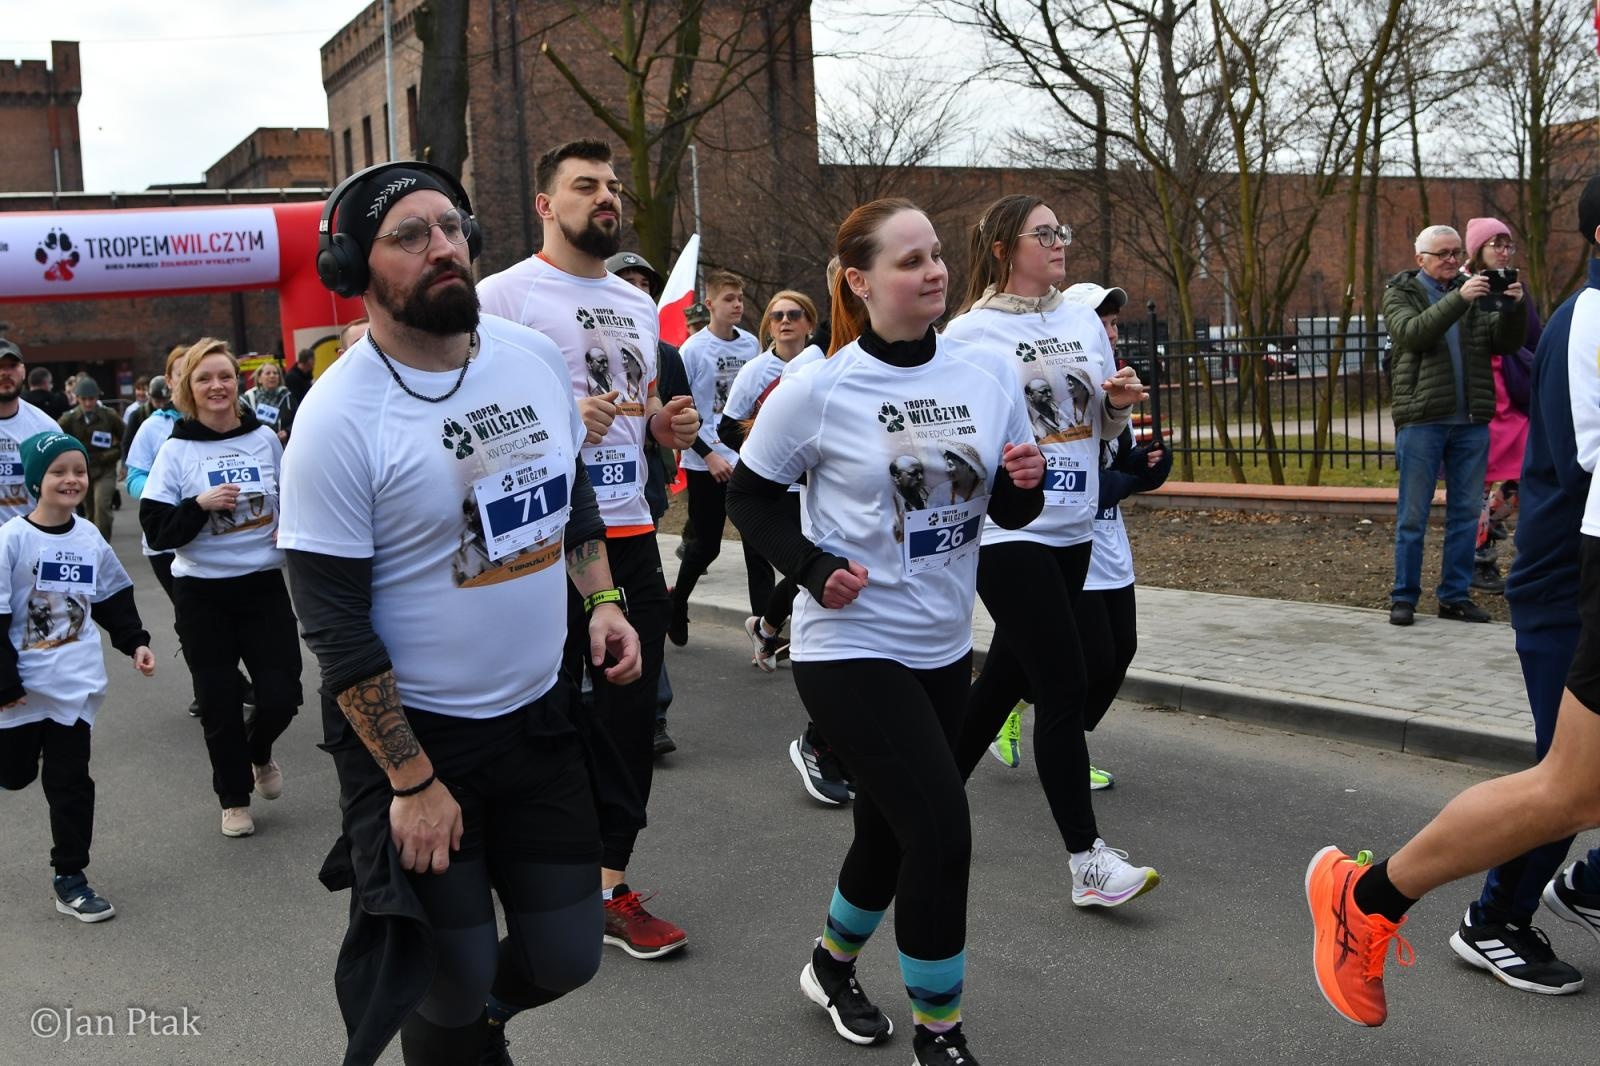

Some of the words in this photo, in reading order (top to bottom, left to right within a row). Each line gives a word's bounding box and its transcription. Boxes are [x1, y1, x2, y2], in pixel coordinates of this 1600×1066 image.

[596, 315, 636, 328] WILCZYM
[1034, 337, 1059, 346] TROPEM
[1038, 341, 1083, 355] WILCZYM
[465, 403, 501, 423] TROPEM
[904, 398, 937, 410] TROPEM
[472, 405, 539, 441] WILCZYM
[908, 405, 970, 424] WILCZYM
[928, 428, 957, 438] EDYCJA
[957, 425, 976, 435] 2026
[486, 445, 500, 460] XIV
[500, 437, 530, 455] EDYCJA
[529, 429, 549, 444] 2026
[220, 468, 252, 484] 126
[515, 466, 532, 477] TROPEM
[516, 466, 548, 486] WILCZYM
[602, 464, 624, 484] 88
[1052, 471, 1076, 491] 20
[514, 486, 549, 523] 71
[942, 511, 969, 523] WILCZYM
[936, 524, 964, 552] 26
[60, 564, 80, 581] 96
